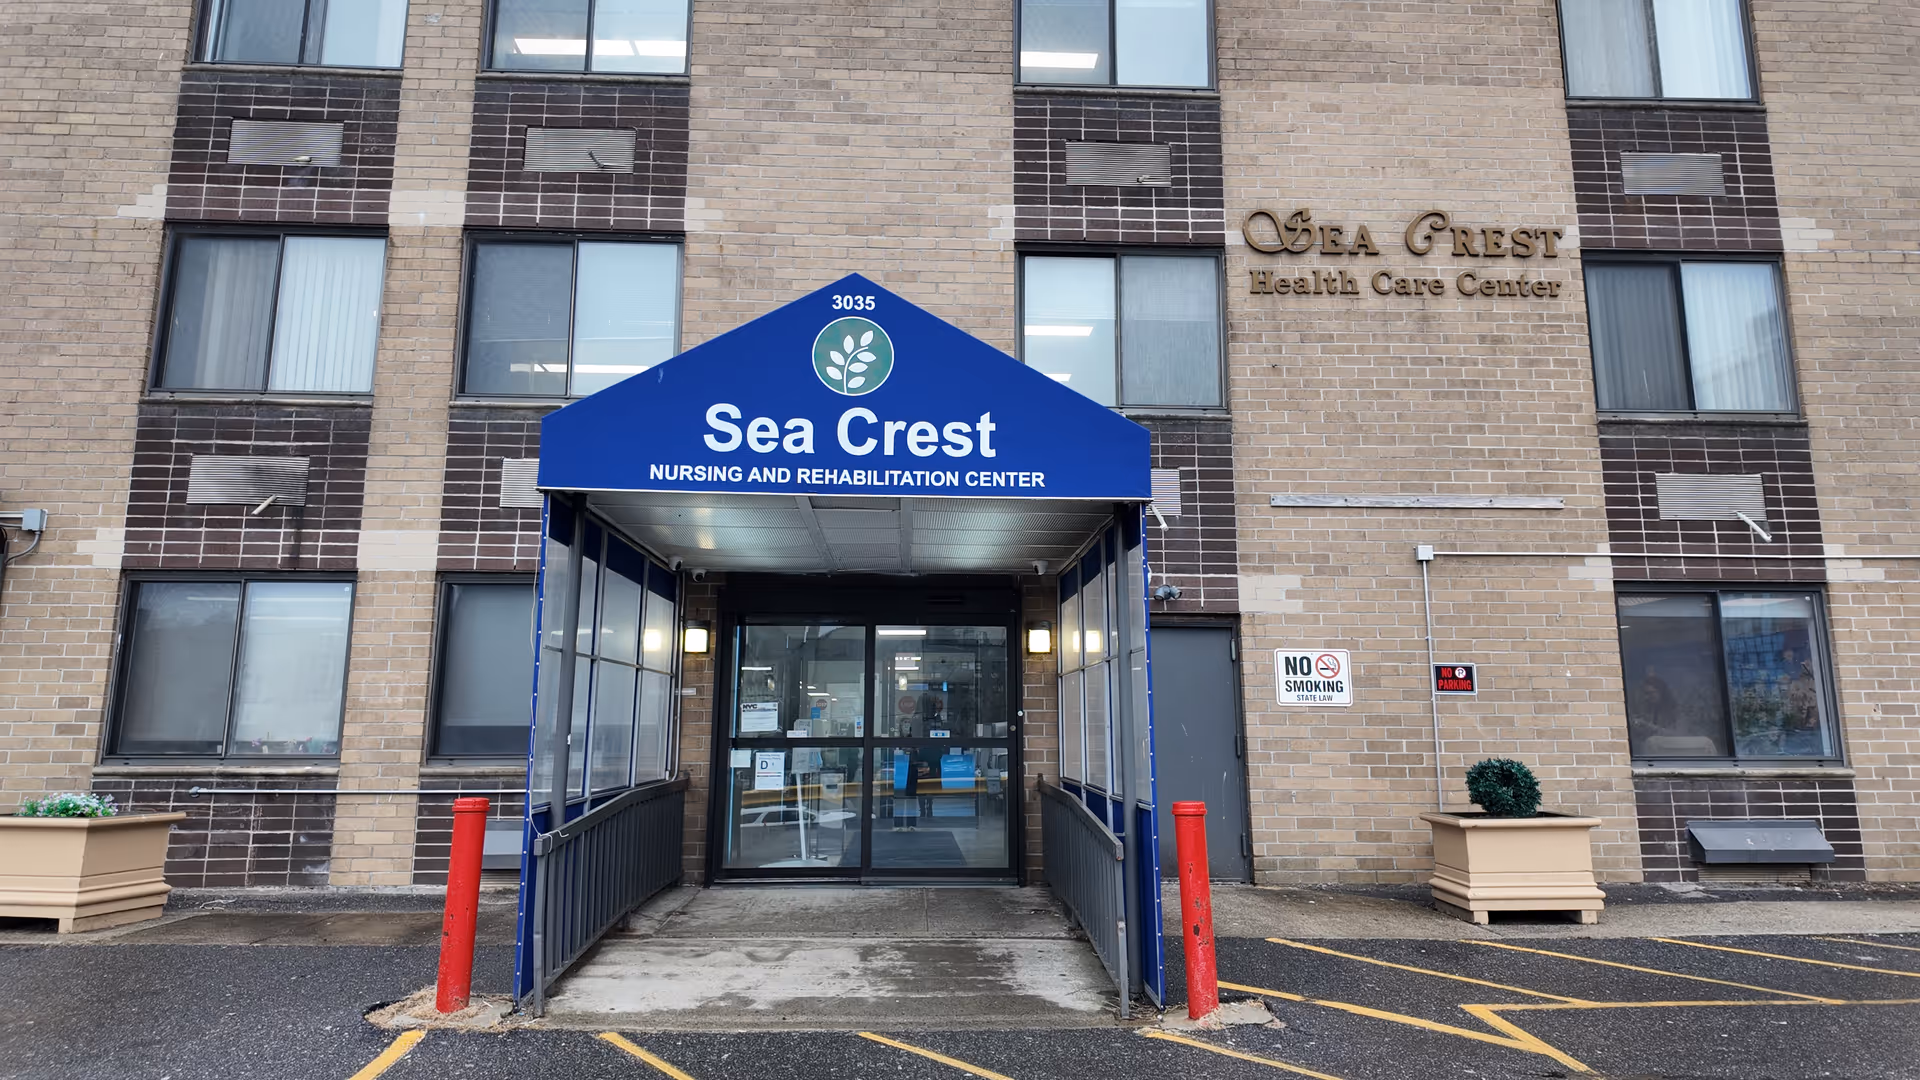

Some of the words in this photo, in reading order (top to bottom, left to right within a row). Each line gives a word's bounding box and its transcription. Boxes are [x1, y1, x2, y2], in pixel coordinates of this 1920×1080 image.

[1243, 207, 1380, 255] SEA
[1405, 209, 1563, 258] CREST
[1249, 270, 1360, 295] Health
[1371, 270, 1445, 296] Care
[1456, 271, 1563, 297] Center
[832, 294, 876, 311] 3035
[703, 403, 815, 454] Sea
[837, 407, 996, 458] Crest
[650, 464, 743, 482] NURSING
[747, 467, 791, 484] AND
[797, 469, 959, 487] REHABILITATION
[965, 471, 1045, 488] CENTER
[1284, 656, 1312, 676] NO
[1441, 667, 1453, 678] NO
[1285, 680, 1344, 693] SMOKING
[1438, 679, 1472, 690] PARKING
[1297, 694, 1317, 702] STATE
[1319, 694, 1333, 702] LAW
[761, 760, 769, 770] D
